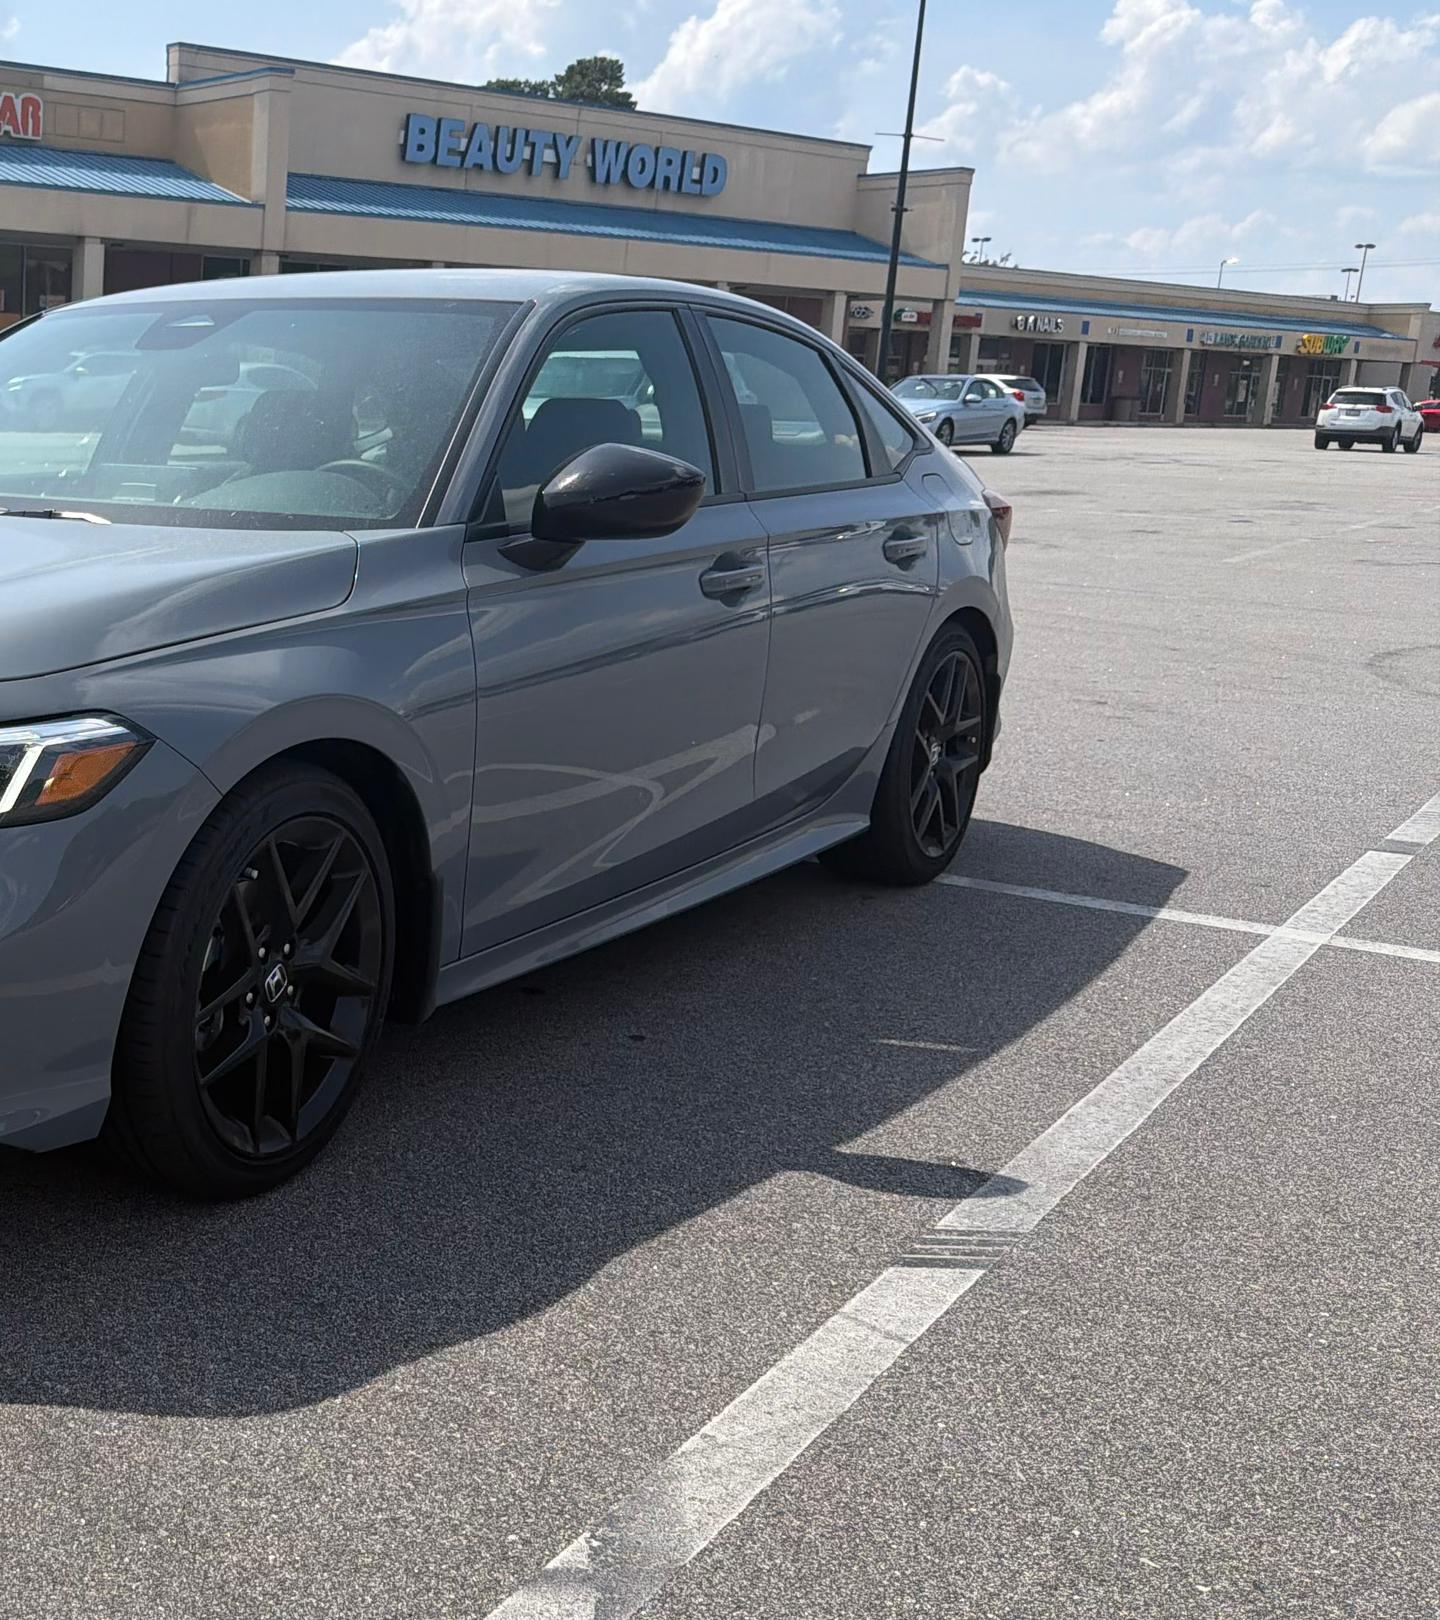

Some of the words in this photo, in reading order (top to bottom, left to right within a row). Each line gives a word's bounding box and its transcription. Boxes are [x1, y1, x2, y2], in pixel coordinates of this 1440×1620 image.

[404, 112, 582, 180] BEAUTY
[590, 137, 728, 198] WORLD
[1035, 316, 1065, 333] NAILS
[1298, 334, 1351, 356] SUBWAY
